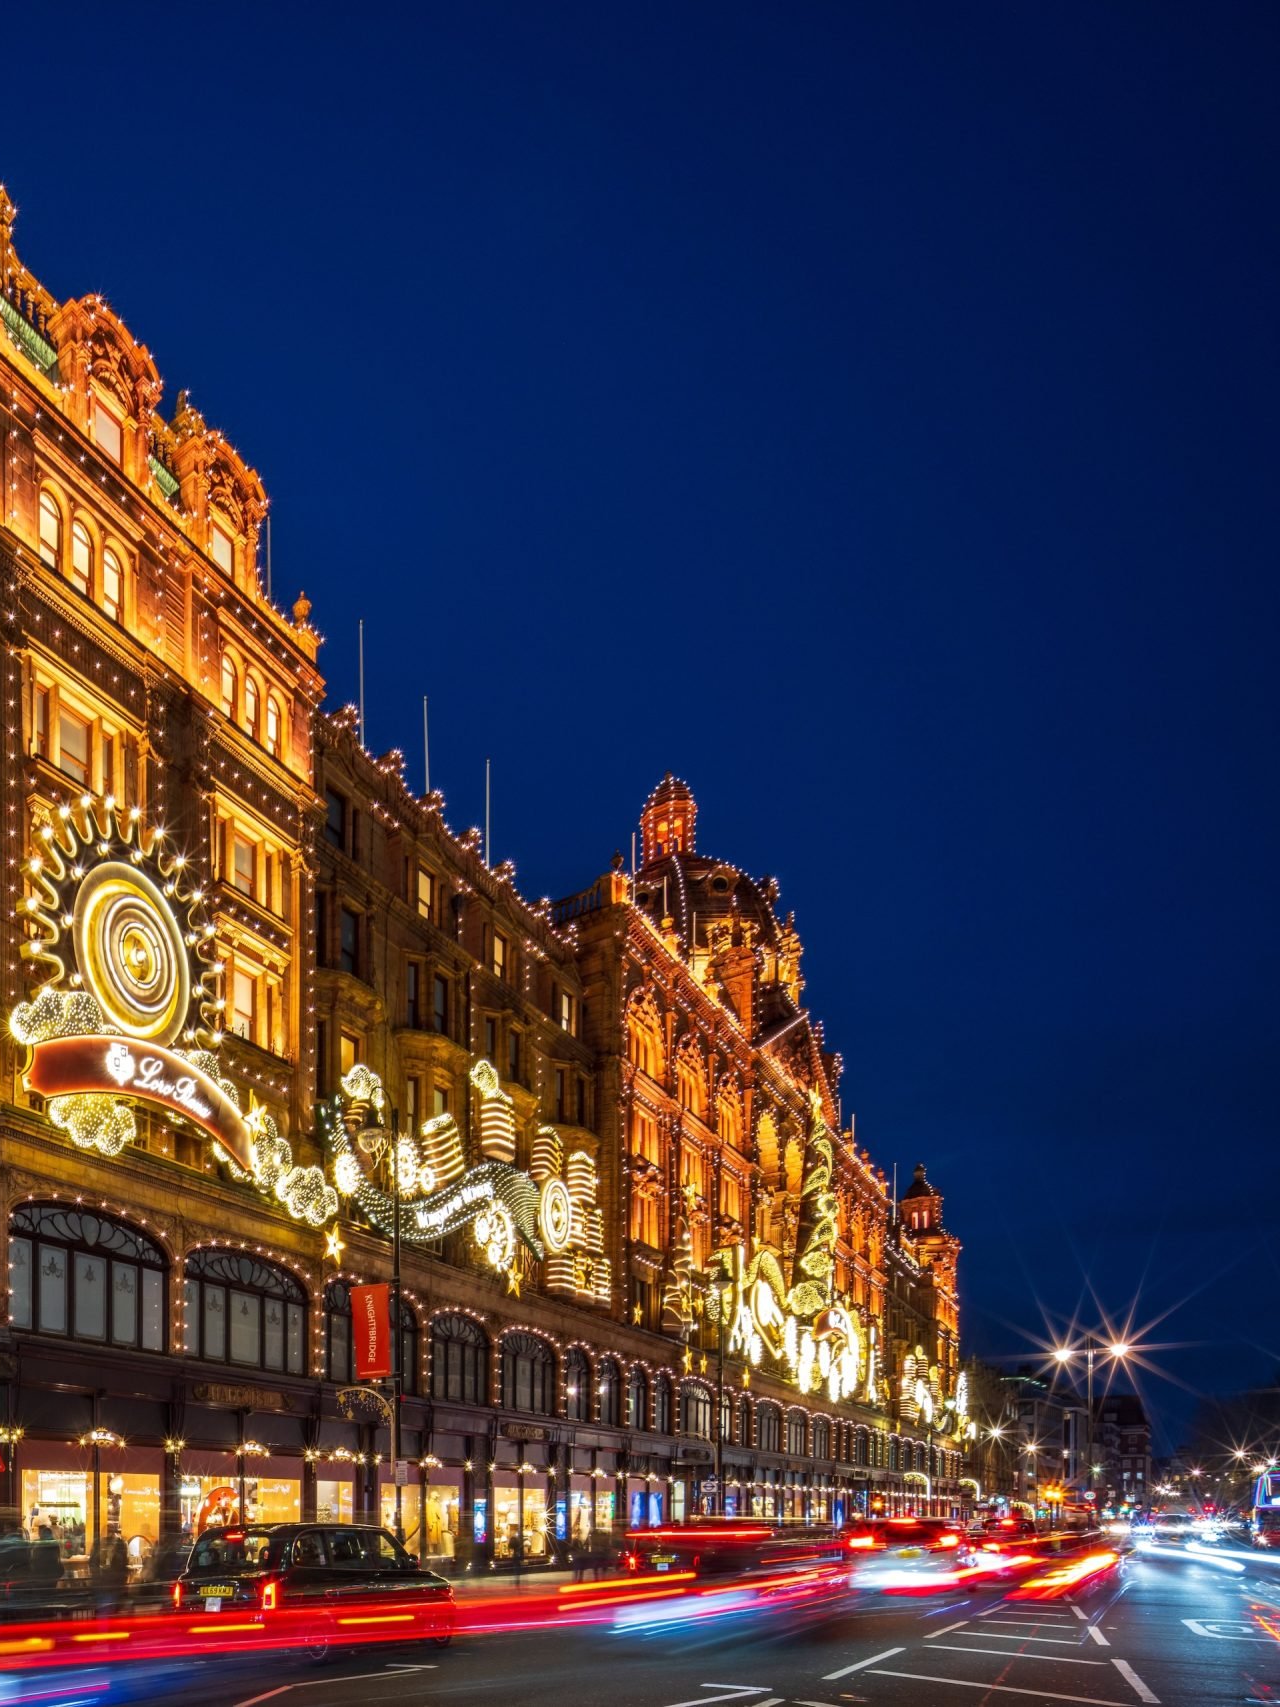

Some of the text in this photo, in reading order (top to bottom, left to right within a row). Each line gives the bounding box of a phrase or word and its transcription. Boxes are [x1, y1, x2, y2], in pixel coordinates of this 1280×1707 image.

[133, 1057, 212, 1119] Loro Piana
[364, 1294, 377, 1363] KNIGHTSBRIDGE
